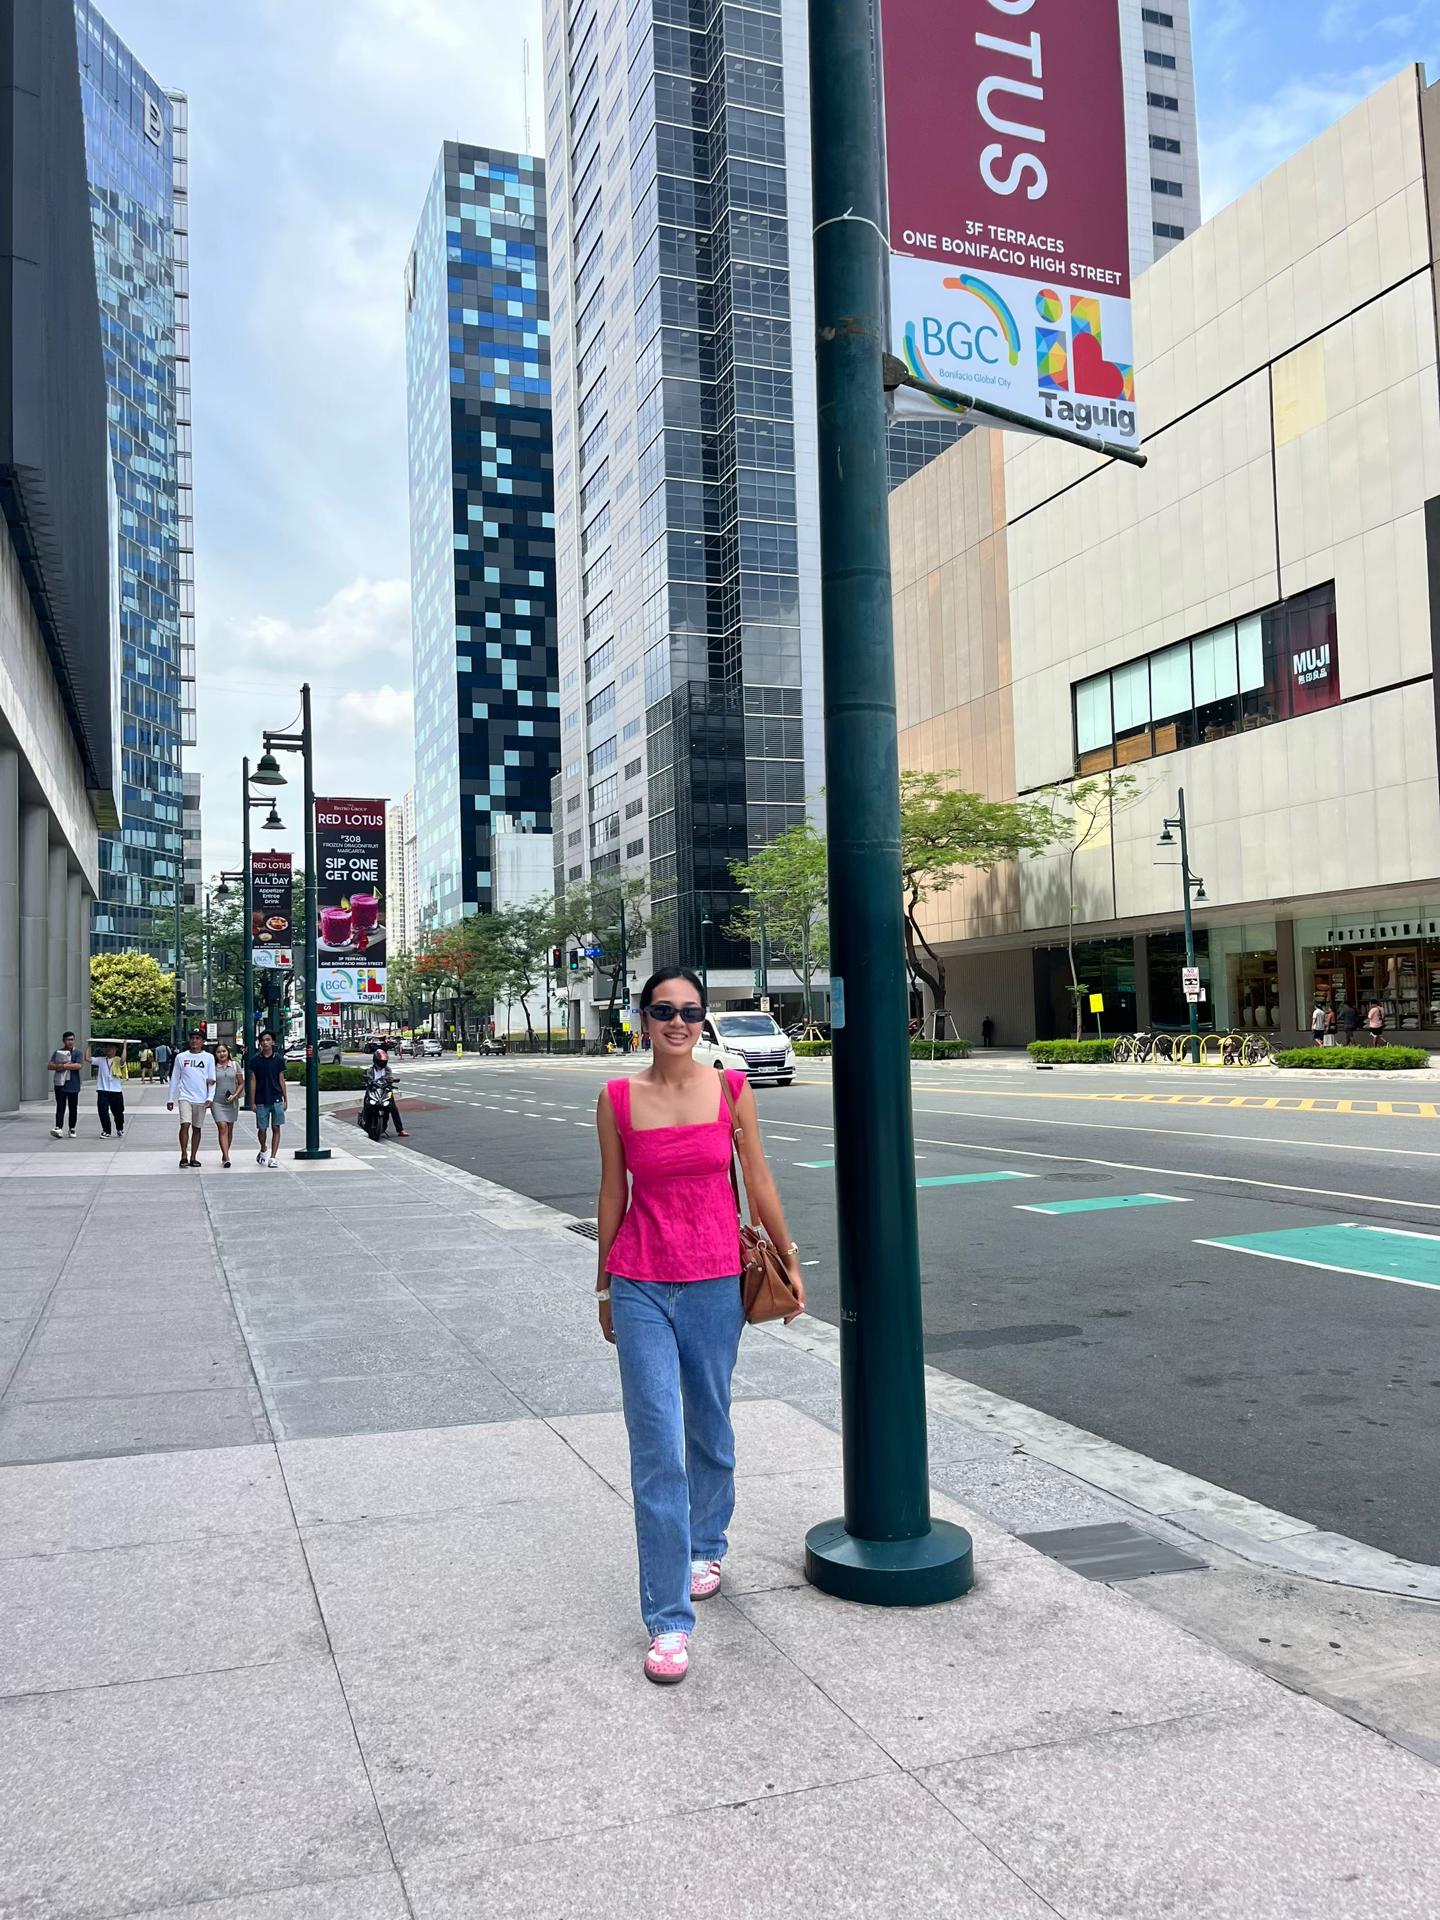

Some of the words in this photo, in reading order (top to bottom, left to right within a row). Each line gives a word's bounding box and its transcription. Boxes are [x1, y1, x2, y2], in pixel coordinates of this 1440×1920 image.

[965, 220, 983, 236] 3F
[988, 225, 1065, 253] TERRACES
[903, 230, 937, 249] ONE
[942, 236, 1026, 266] BONIFACIO
[1030, 253, 1066, 274] HIGH
[1070, 263, 1122, 286] STREET
[922, 316, 999, 364] BGC
[939, 368, 973, 382] Bonifacio
[974, 373, 996, 385] Global
[997, 377, 1012, 389] City
[1038, 391, 1136, 437] Taguig
[1293, 643, 1330, 674] MUJI
[318, 813, 341, 825] RED
[345, 814, 383, 826] LOTUS
[268, 862, 291, 870] LOTUS
[325, 858, 347, 869] SIP
[349, 858, 379, 870] ONE
[254, 877, 270, 885] ALL
[272, 877, 289, 885] DAY
[325, 870, 348, 881] GET
[351, 871, 379, 882] ONE
[325, 980, 347, 990] BGC
[357, 993, 385, 1001] Taguig
[183, 1059, 204, 1068] FILA
